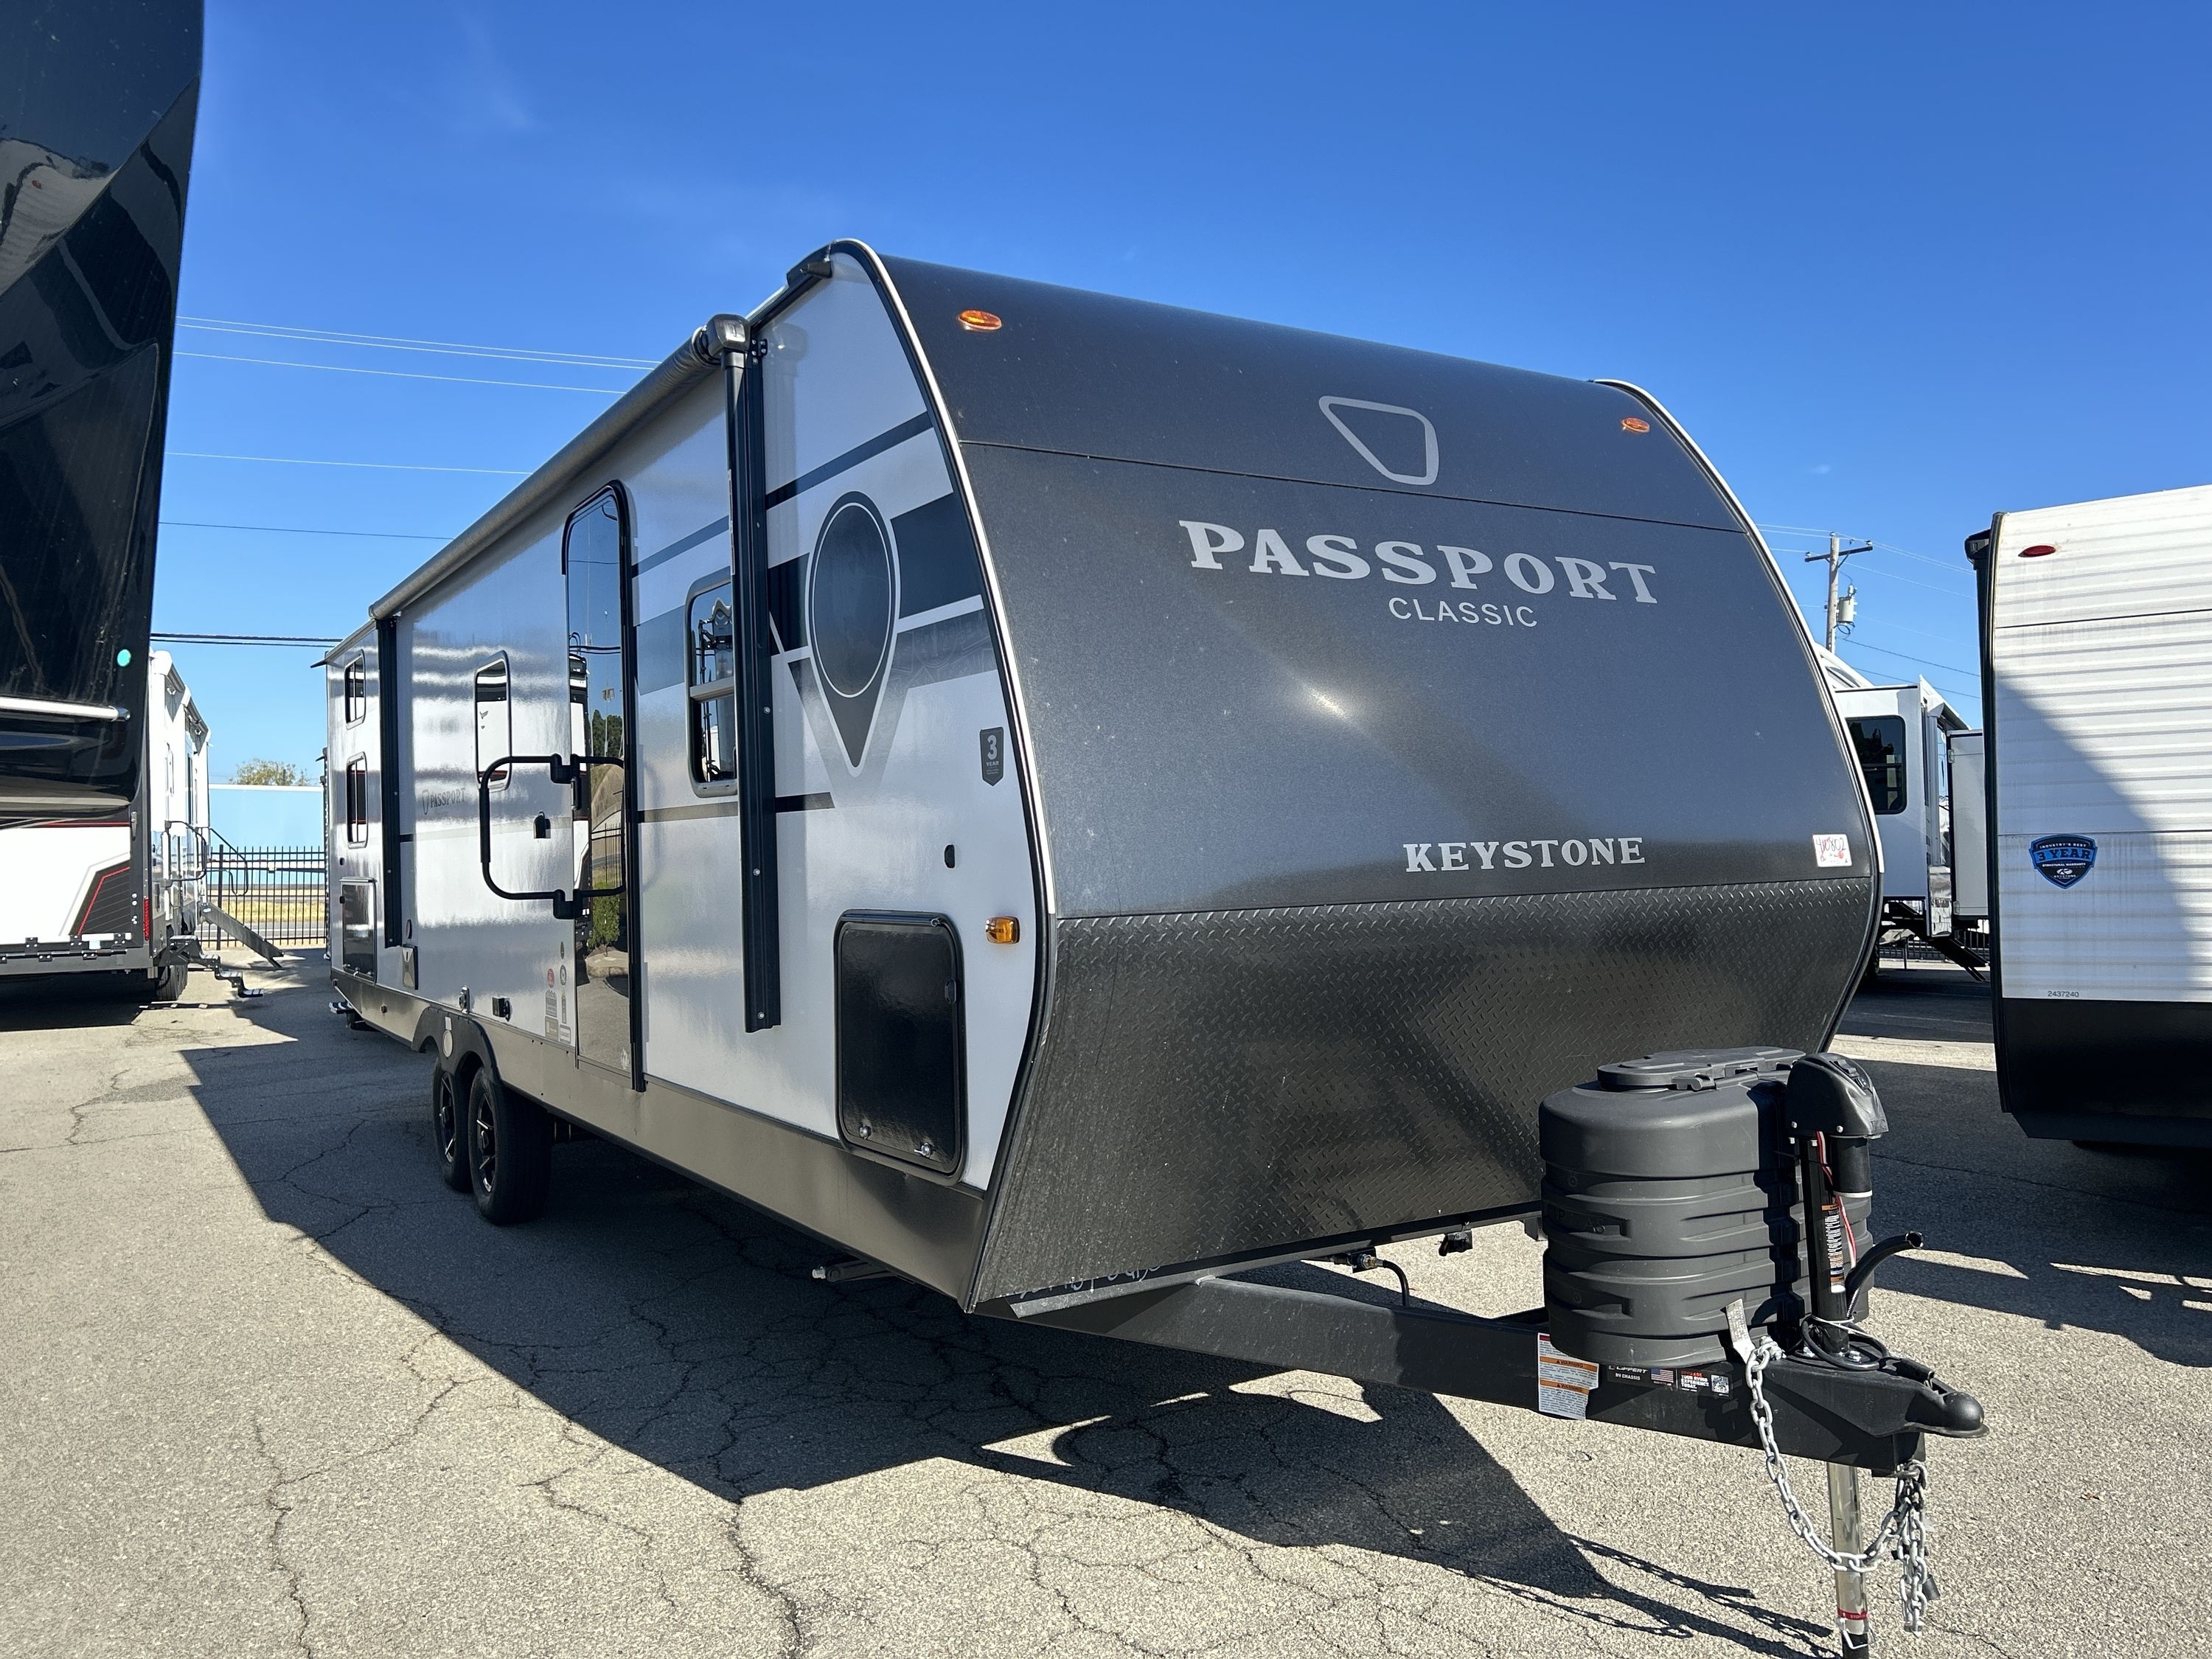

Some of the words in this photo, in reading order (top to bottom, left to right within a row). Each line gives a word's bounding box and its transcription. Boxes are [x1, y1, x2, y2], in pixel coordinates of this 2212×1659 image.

[1179, 520, 1658, 604] PASSPORT
[1388, 597, 1538, 627] CLASSIC
[987, 734, 997, 760] 3
[431, 787, 466, 808] PASSPORT
[1403, 838, 1645, 872] KEYSTONE
[2037, 852, 2045, 860] 3
[2049, 848, 2090, 859] YEAR
